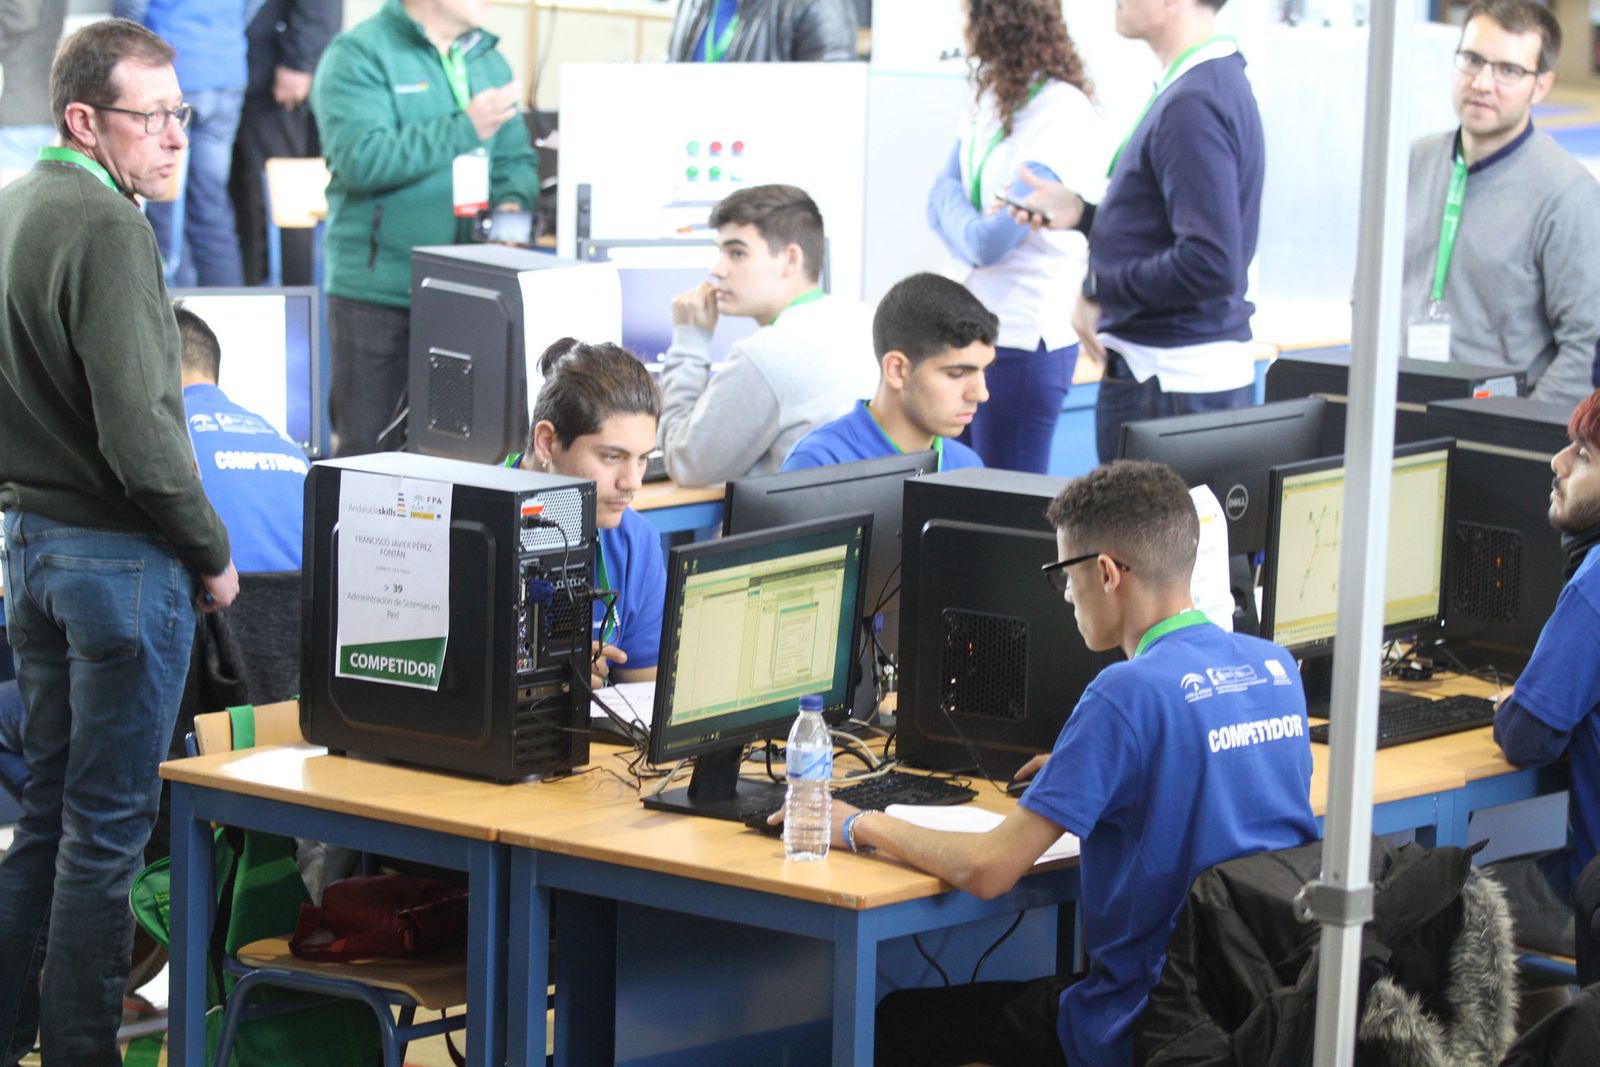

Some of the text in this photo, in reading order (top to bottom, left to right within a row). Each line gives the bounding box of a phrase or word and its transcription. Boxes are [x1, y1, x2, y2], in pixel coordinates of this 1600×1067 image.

[355, 535, 390, 547] FRANCISCO
[391, 539, 411, 550] JAVIER
[392, 584, 403, 593] 39
[347, 592, 393, 605] Administración
[403, 598, 430, 610] Sistemas
[431, 604, 441, 612] en
[386, 610, 400, 619] Red
[350, 652, 436, 679] COMPETIDOR
[1208, 715, 1303, 753] COMPETIDOR
